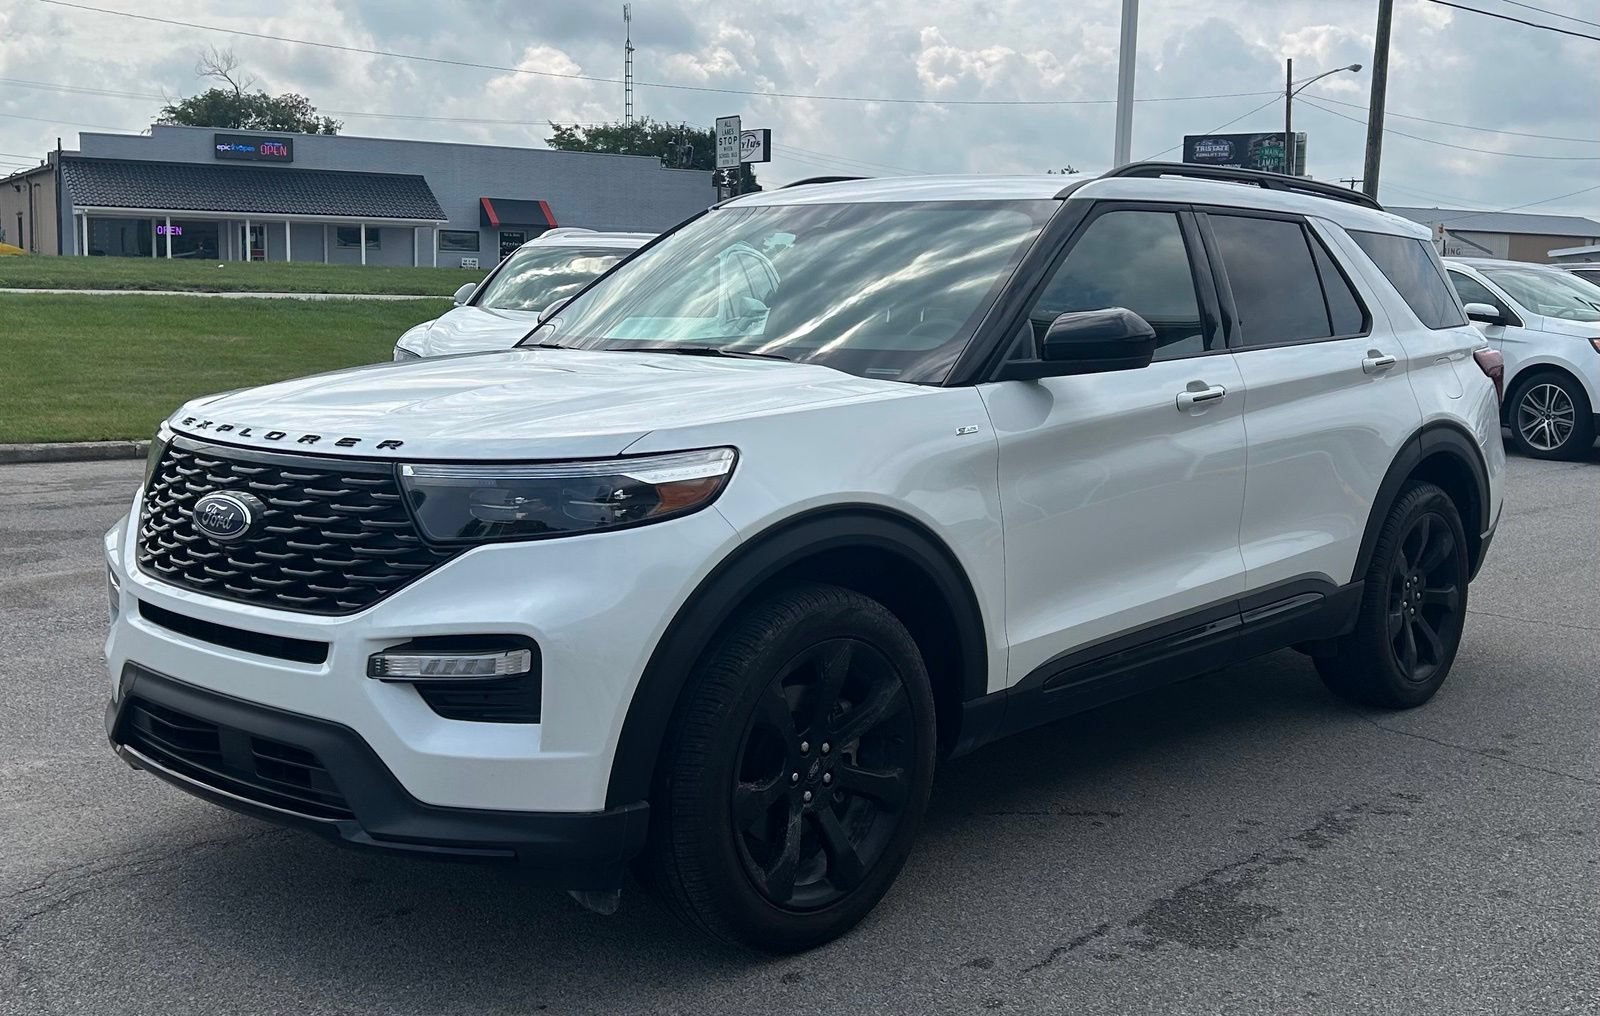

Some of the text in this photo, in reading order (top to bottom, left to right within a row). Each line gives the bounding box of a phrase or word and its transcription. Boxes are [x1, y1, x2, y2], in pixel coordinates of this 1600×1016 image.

[719, 135, 738, 146] STOP
[260, 144, 287, 156] OPEN
[1257, 158, 1279, 167] LAMAR
[181, 417, 404, 450] EXPLORER
[201, 502, 234, 530] Ford
